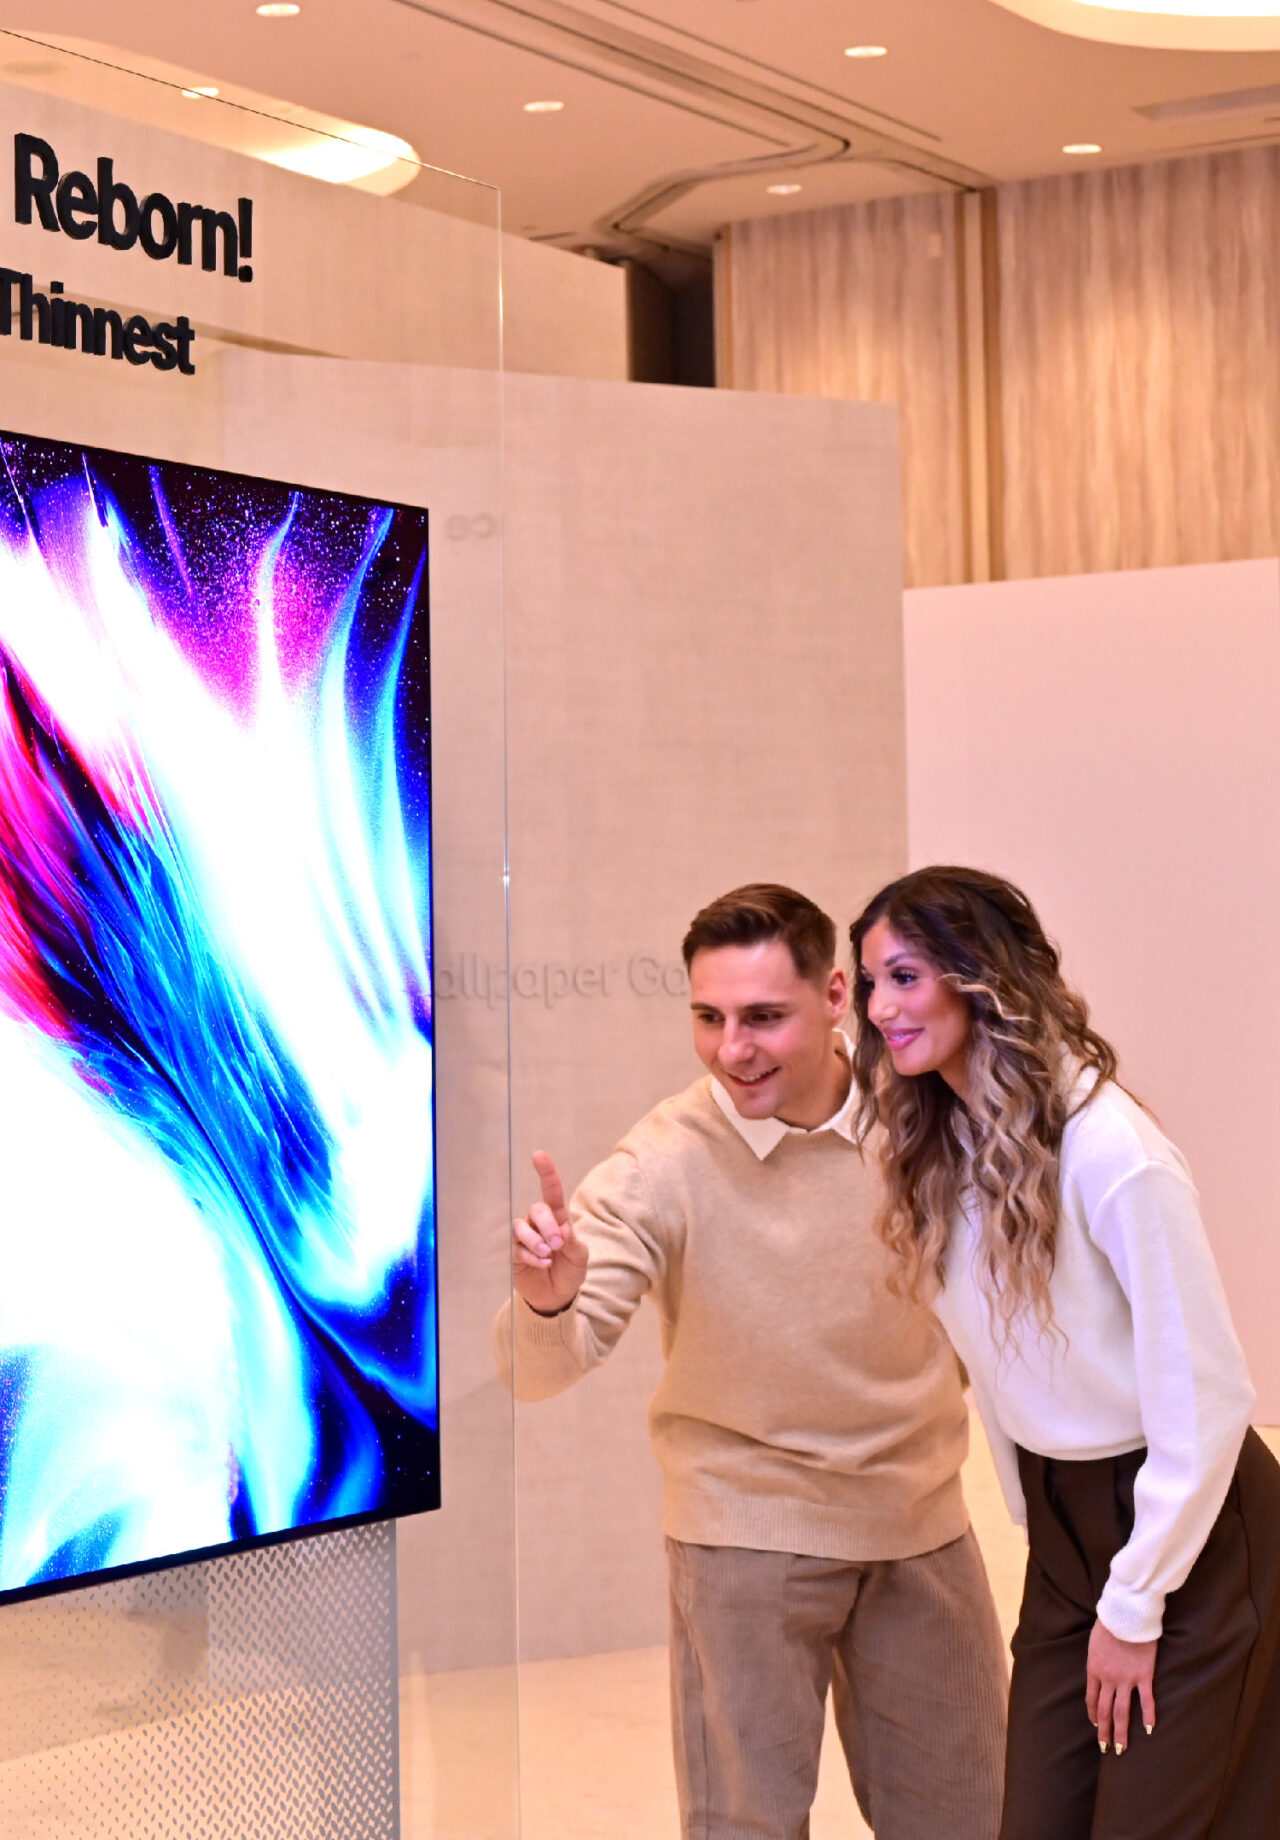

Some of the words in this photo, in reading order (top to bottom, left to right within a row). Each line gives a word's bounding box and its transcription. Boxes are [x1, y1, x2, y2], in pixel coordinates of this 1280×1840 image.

[14, 132, 254, 283] Reborn!
[434, 950, 618, 1010] allpaper
[626, 949, 689, 998] Ga
